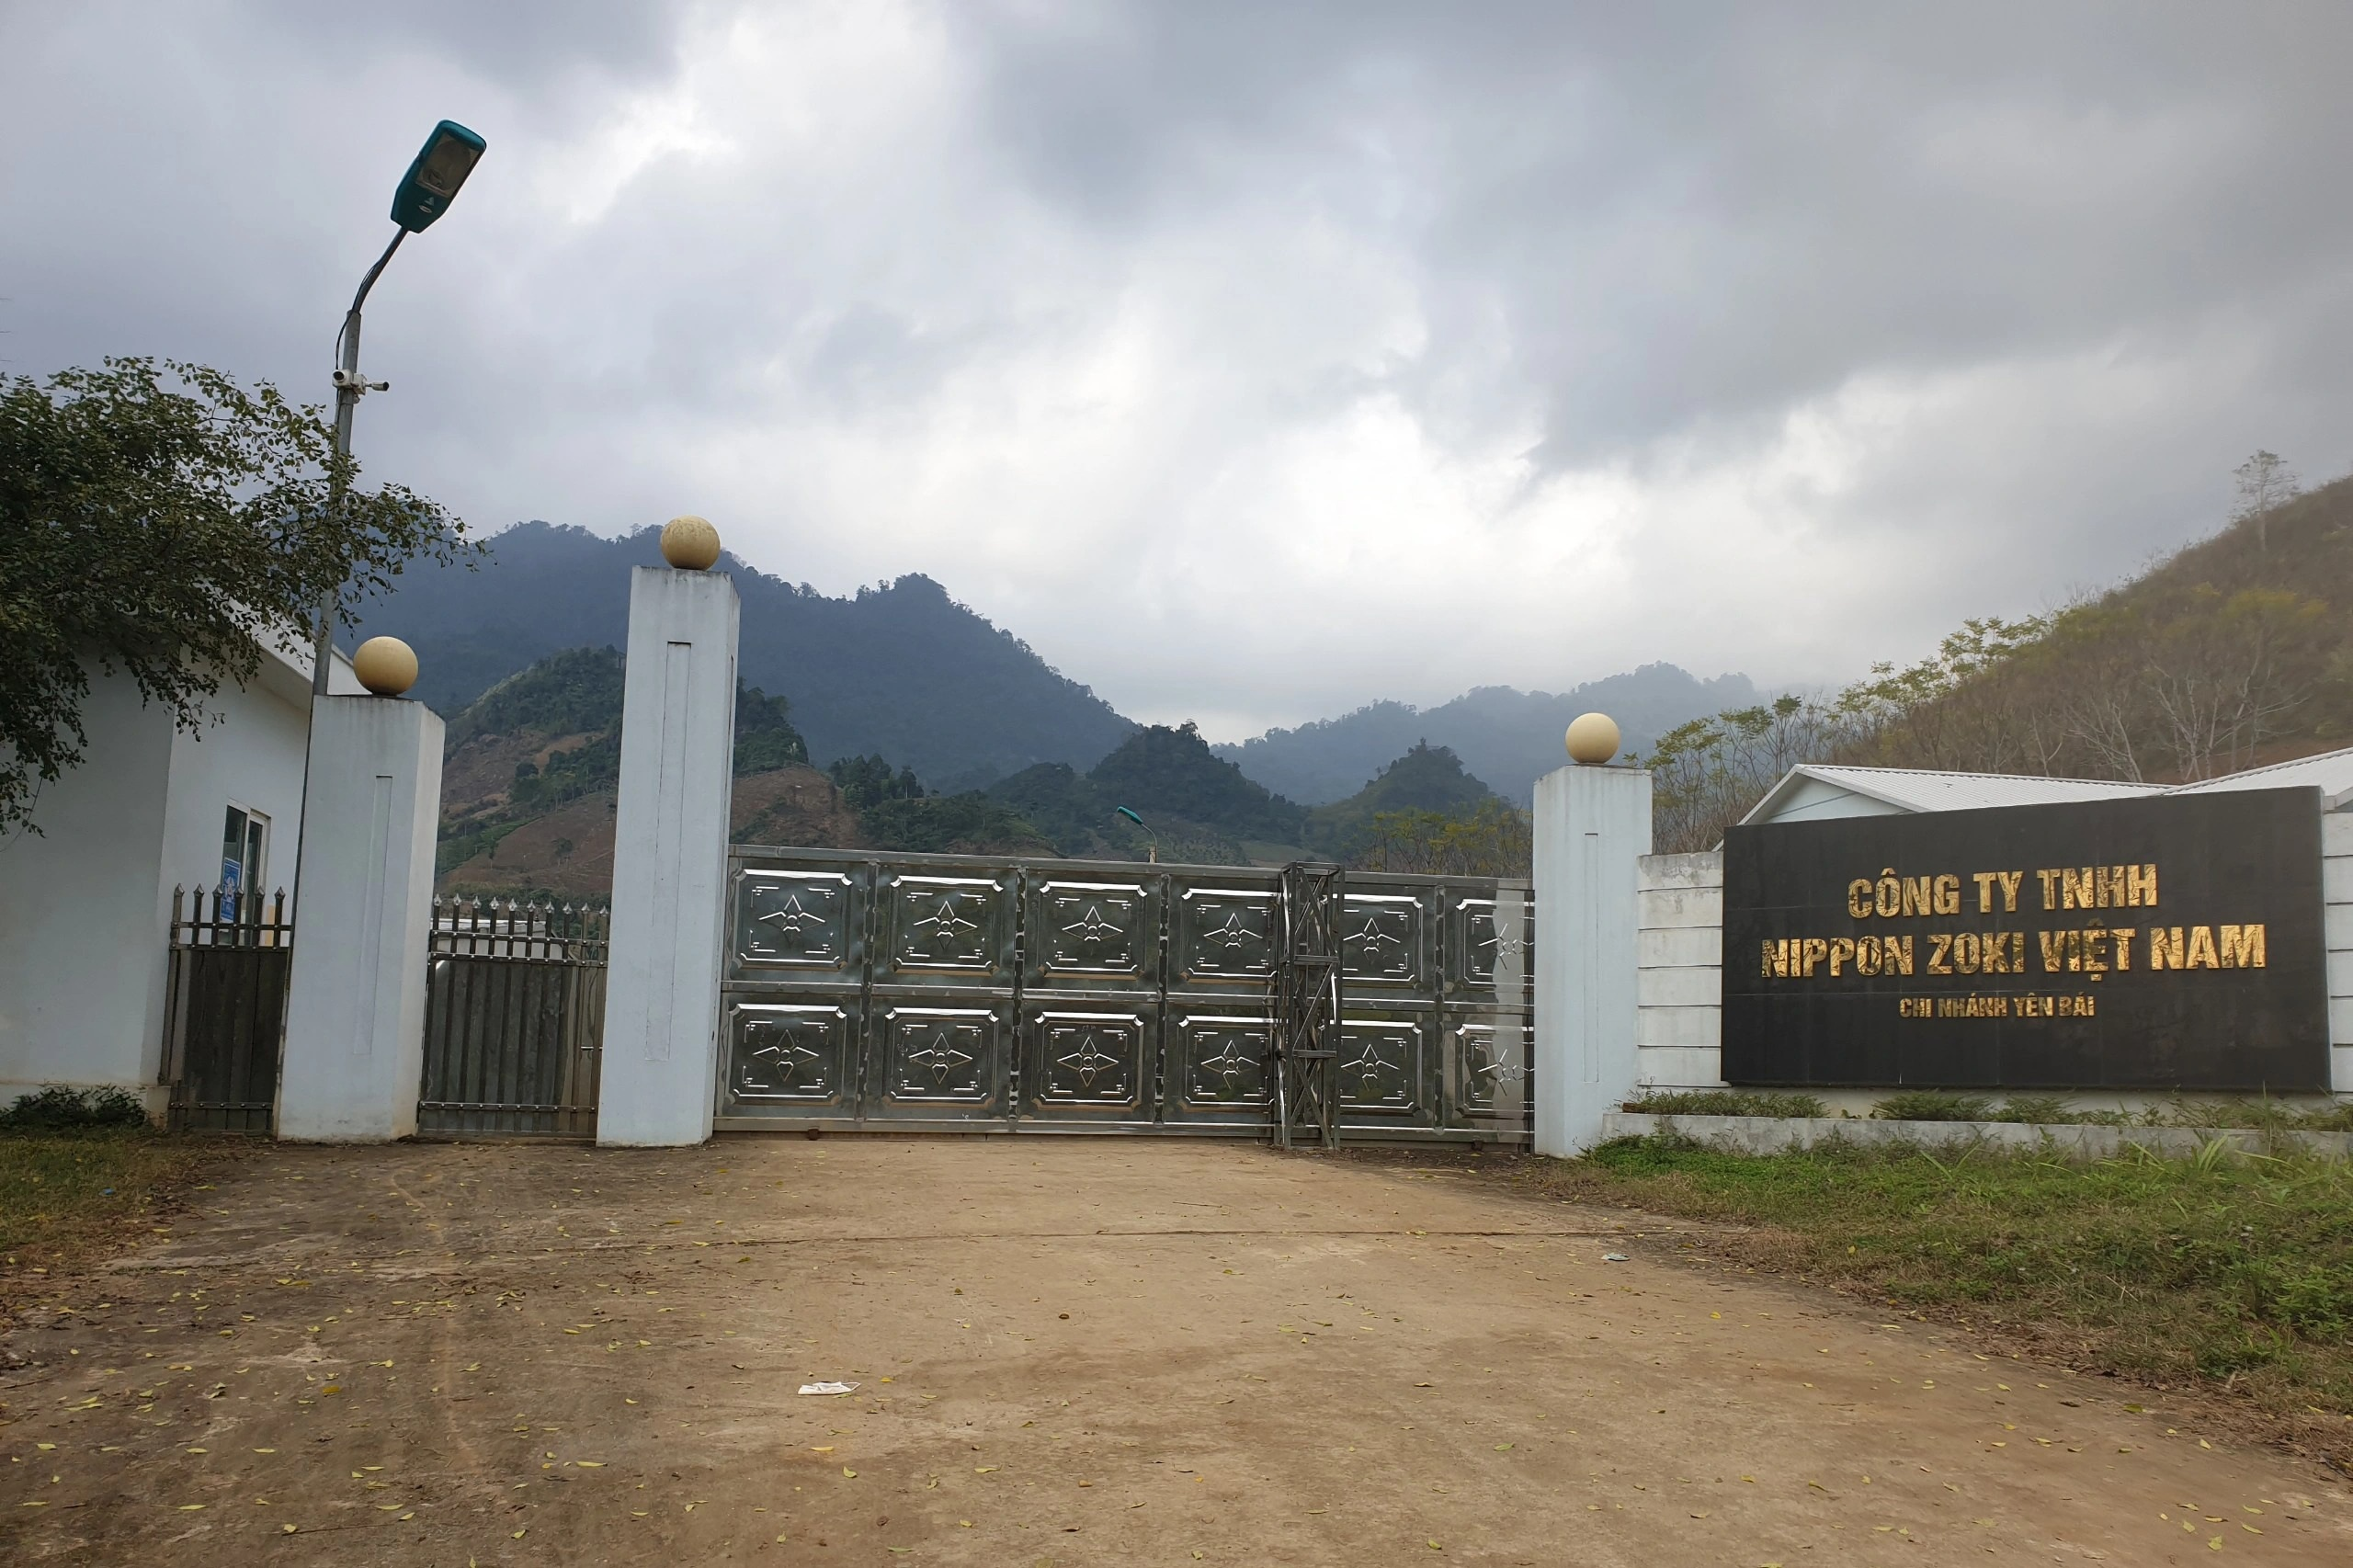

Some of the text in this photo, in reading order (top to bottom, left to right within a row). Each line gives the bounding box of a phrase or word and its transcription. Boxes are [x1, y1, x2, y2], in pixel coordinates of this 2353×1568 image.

[1847, 863, 2158, 918] CÔNG TY TNHH
[1761, 917, 2266, 982] NIPPON ZOKI VIỆT NAM
[1899, 991, 2096, 1018] CHI NHÁNH YÊN BÁI
